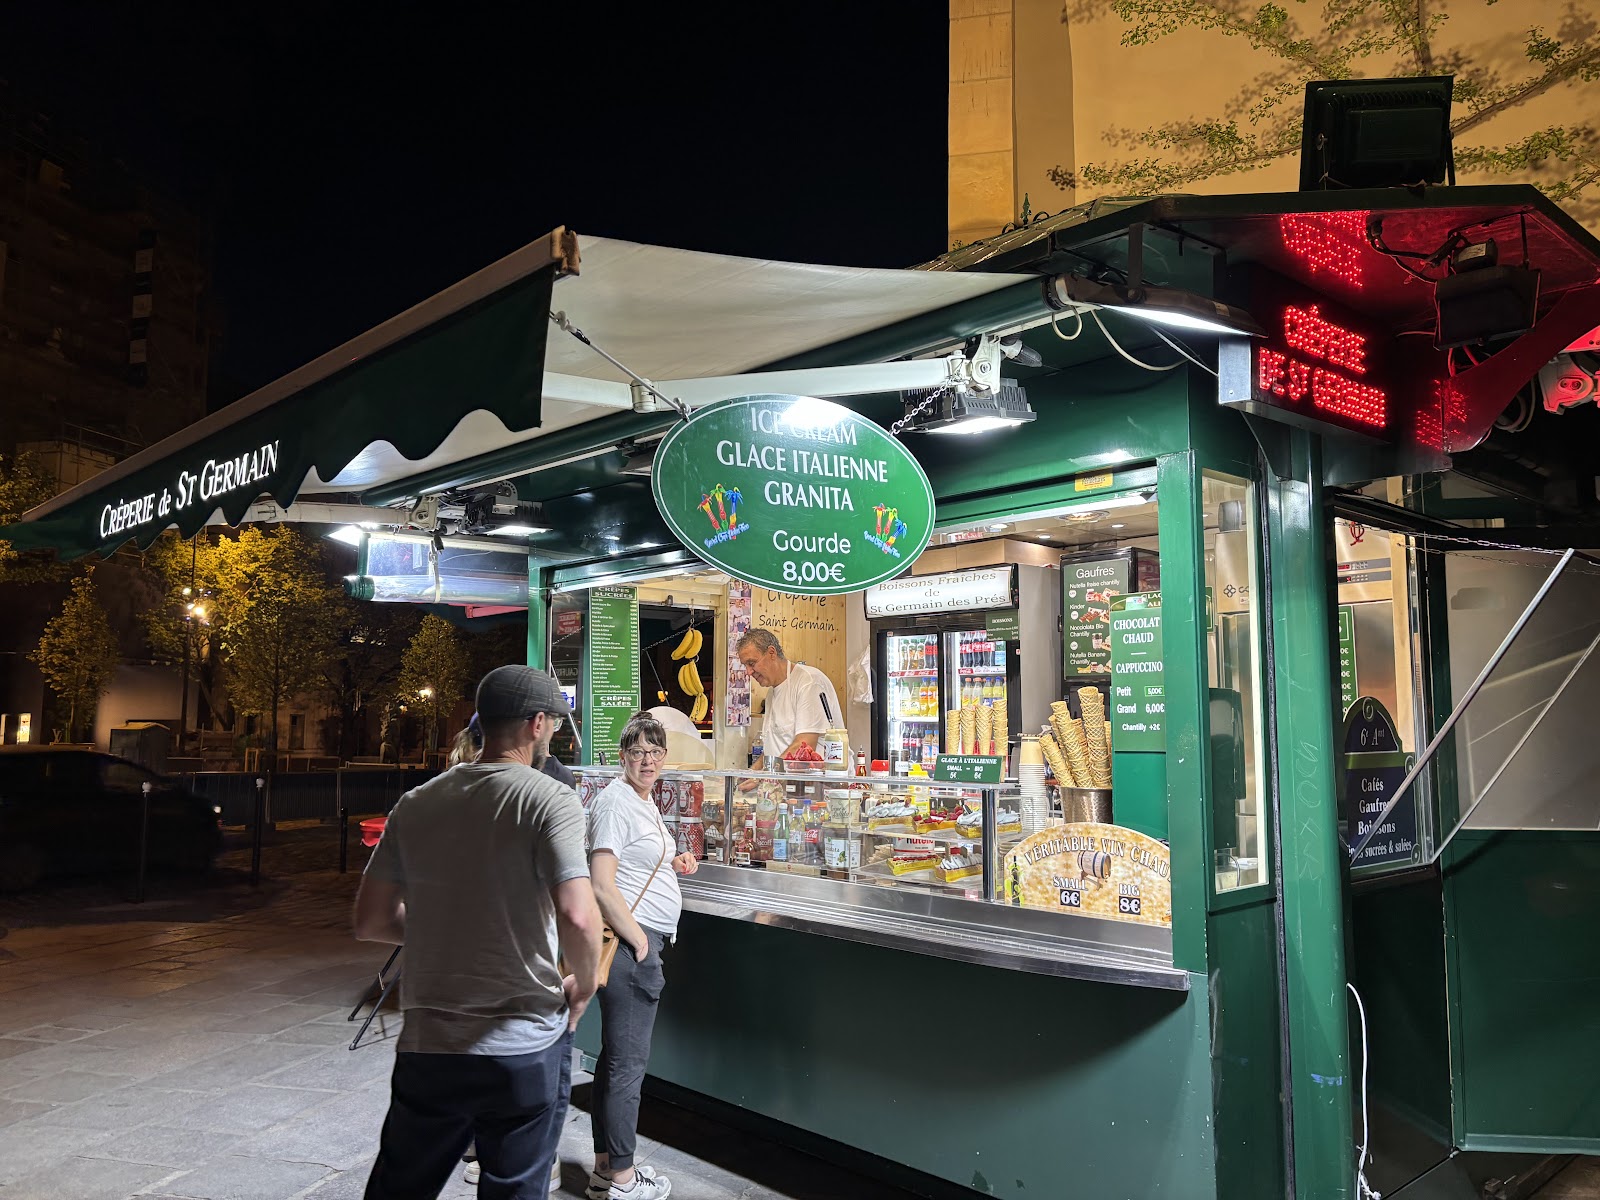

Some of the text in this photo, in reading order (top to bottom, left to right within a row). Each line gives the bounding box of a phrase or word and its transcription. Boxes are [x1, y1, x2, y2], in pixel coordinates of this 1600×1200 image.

[751, 407, 783, 435] ICE
[716, 440, 888, 483] GLACE ITALIENNE
[158, 487, 172, 518] de
[200, 439, 280, 501] GERMAIN
[764, 480, 854, 511] GRANITA
[772, 529, 851, 554] Gourde
[782, 561, 846, 585] 8,00€
[1075, 566, 1115, 579] Gaufres
[878, 572, 997, 592] Boissons Fraîches
[924, 588, 940, 597] de
[870, 593, 1006, 614] St Germain des Prés
[759, 614, 787, 628] Saint
[1113, 616, 1160, 631] CHOCOLAT
[1122, 632, 1154, 645] CHAUD
[1115, 660, 1163, 673] CAPPUCCINO
[1116, 686, 1132, 697] Petit
[1116, 702, 1165, 715] Grand 6,00€
[1122, 723, 1147, 733] Chantilly
[946, 764, 963, 772] SMALL
[958, 756, 963, 764] À
[1361, 777, 1384, 793] Cafés
[1359, 797, 1389, 814] Gaufre
[1024, 836, 1095, 866] VÉRITABLE
[1100, 838, 1125, 858] VIN
[1365, 842, 1387, 858] sucrées
[1388, 840, 1394, 854] &
[1395, 838, 1412, 853] salées
[1052, 876, 1140, 897] SMALL BIG
[1060, 890, 1141, 914] 6€ 8€
